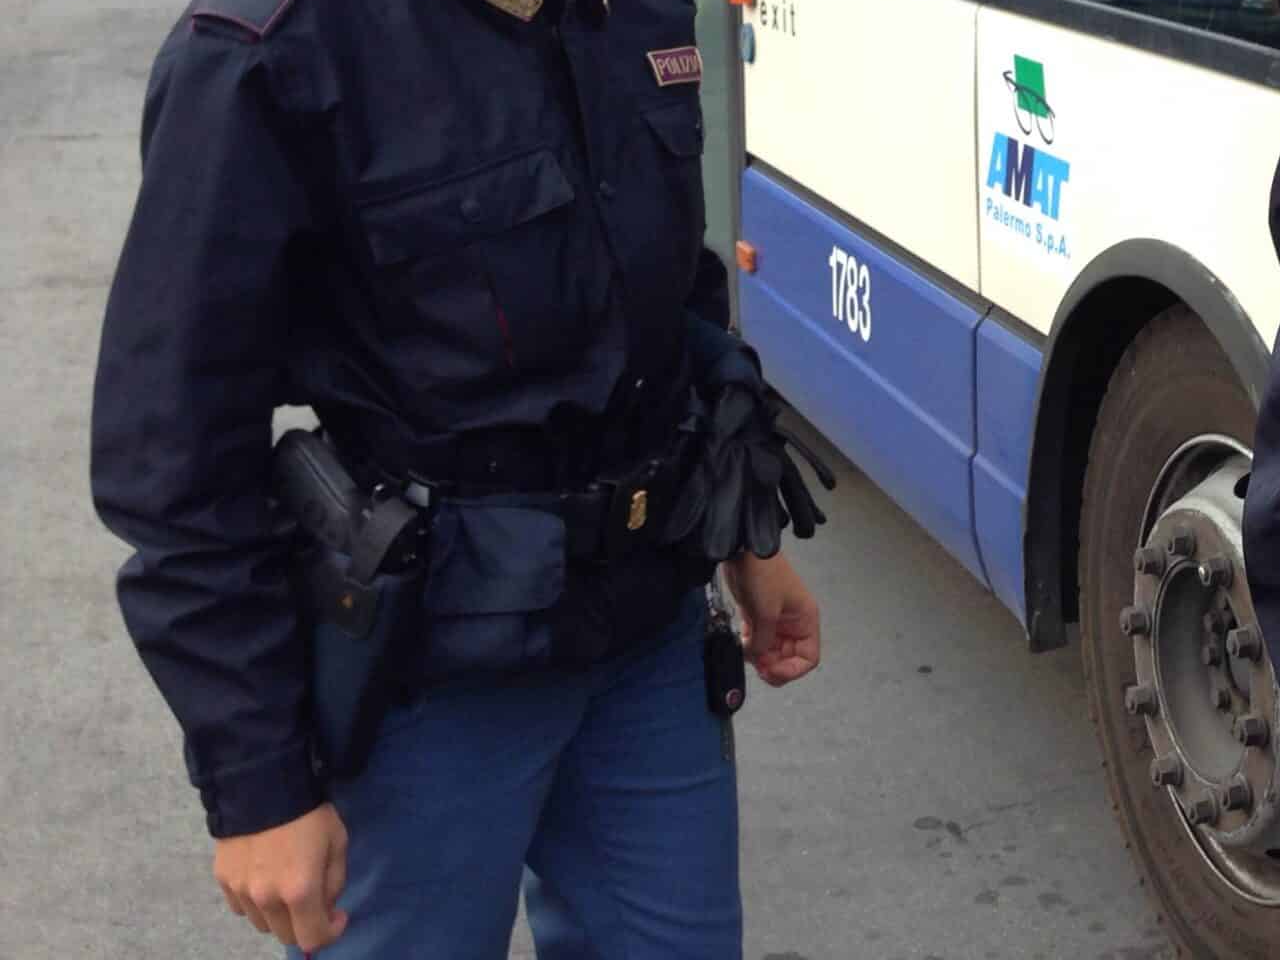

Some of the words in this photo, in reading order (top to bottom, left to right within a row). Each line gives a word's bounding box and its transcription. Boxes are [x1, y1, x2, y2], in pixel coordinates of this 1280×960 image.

[986, 131, 1071, 222] AMAT
[985, 196, 1033, 239] Palermo
[1034, 222, 1072, 260] S.p.A.
[828, 244, 872, 343] 1783
